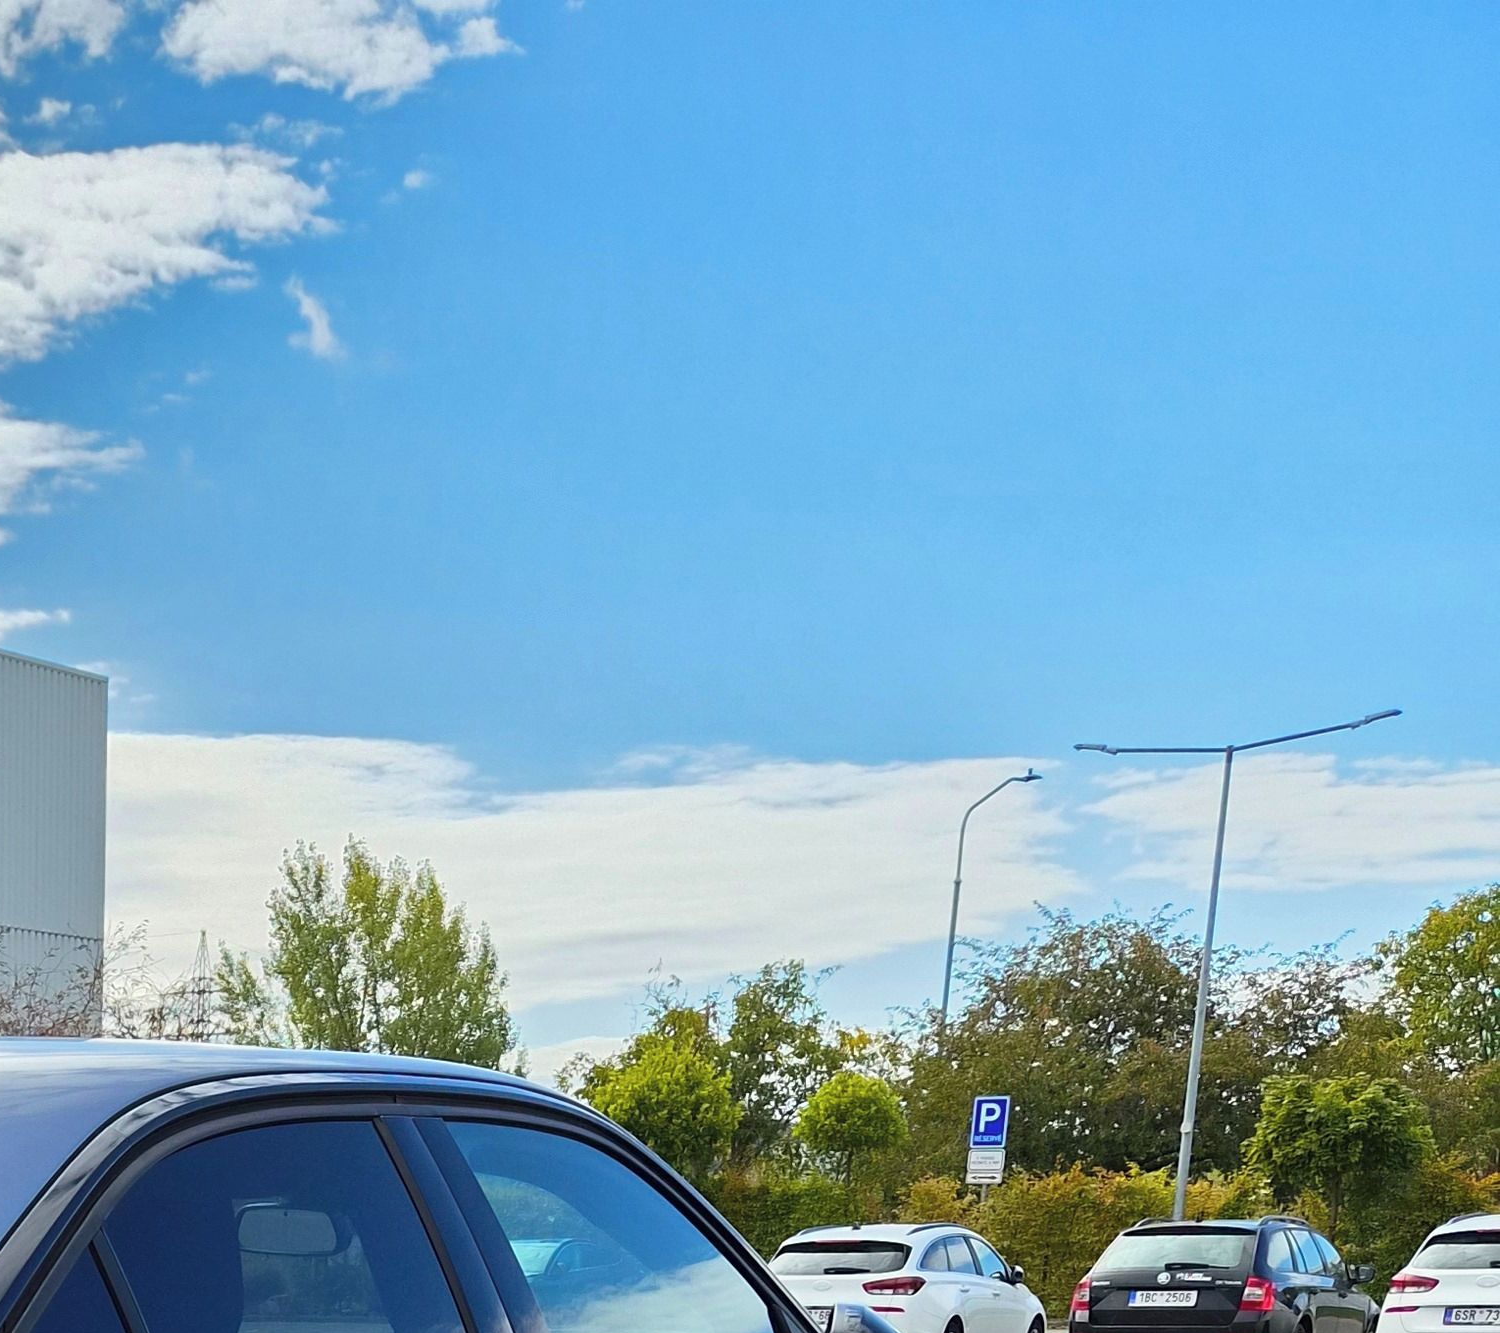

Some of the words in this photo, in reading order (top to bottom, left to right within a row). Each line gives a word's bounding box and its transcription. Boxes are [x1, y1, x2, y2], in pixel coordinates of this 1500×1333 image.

[979, 1103, 1001, 1132] P
[1139, 1292, 1158, 1303] 1BC
[1455, 1309, 1477, 1321] 6SR
